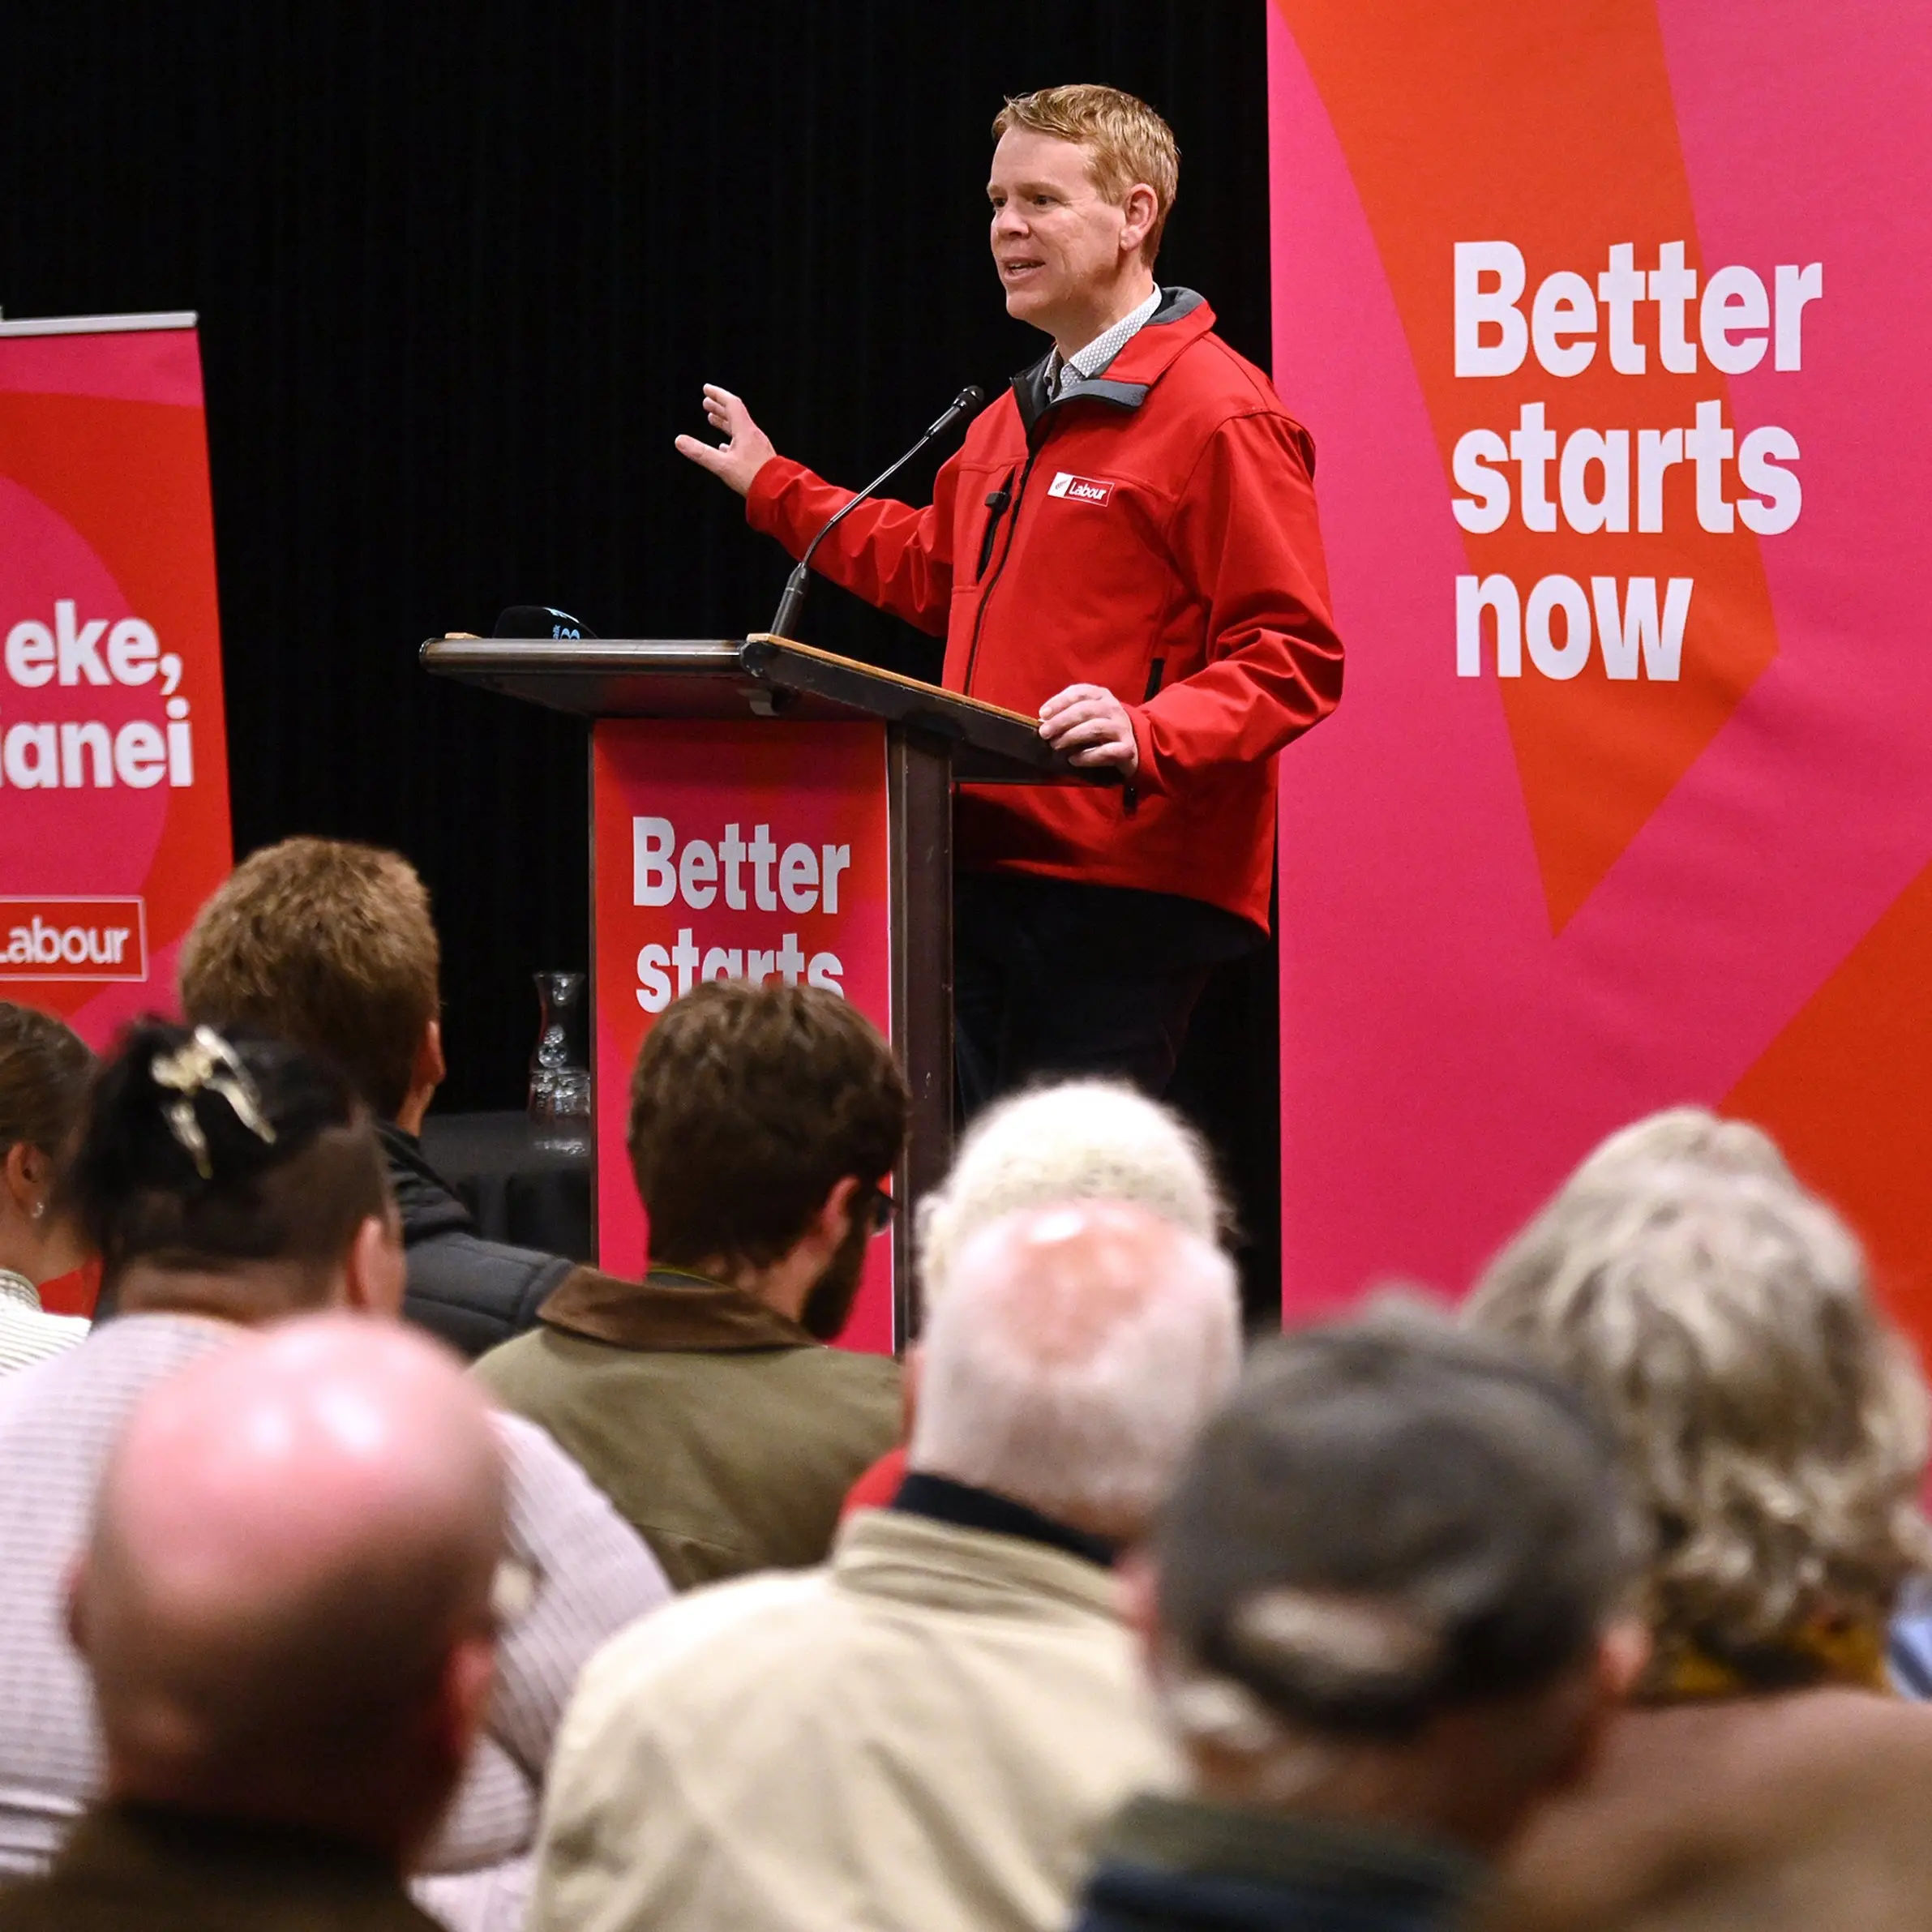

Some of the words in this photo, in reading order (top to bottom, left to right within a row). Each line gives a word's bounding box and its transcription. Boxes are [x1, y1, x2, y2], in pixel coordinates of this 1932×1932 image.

[1454, 240, 1823, 378] Better
[1068, 481, 1107, 500] Labour
[1451, 399, 1802, 536] starts
[5, 598, 184, 696] eke,
[1456, 573, 1694, 681] now
[0, 696, 194, 790] anei
[632, 816, 850, 914] Better
